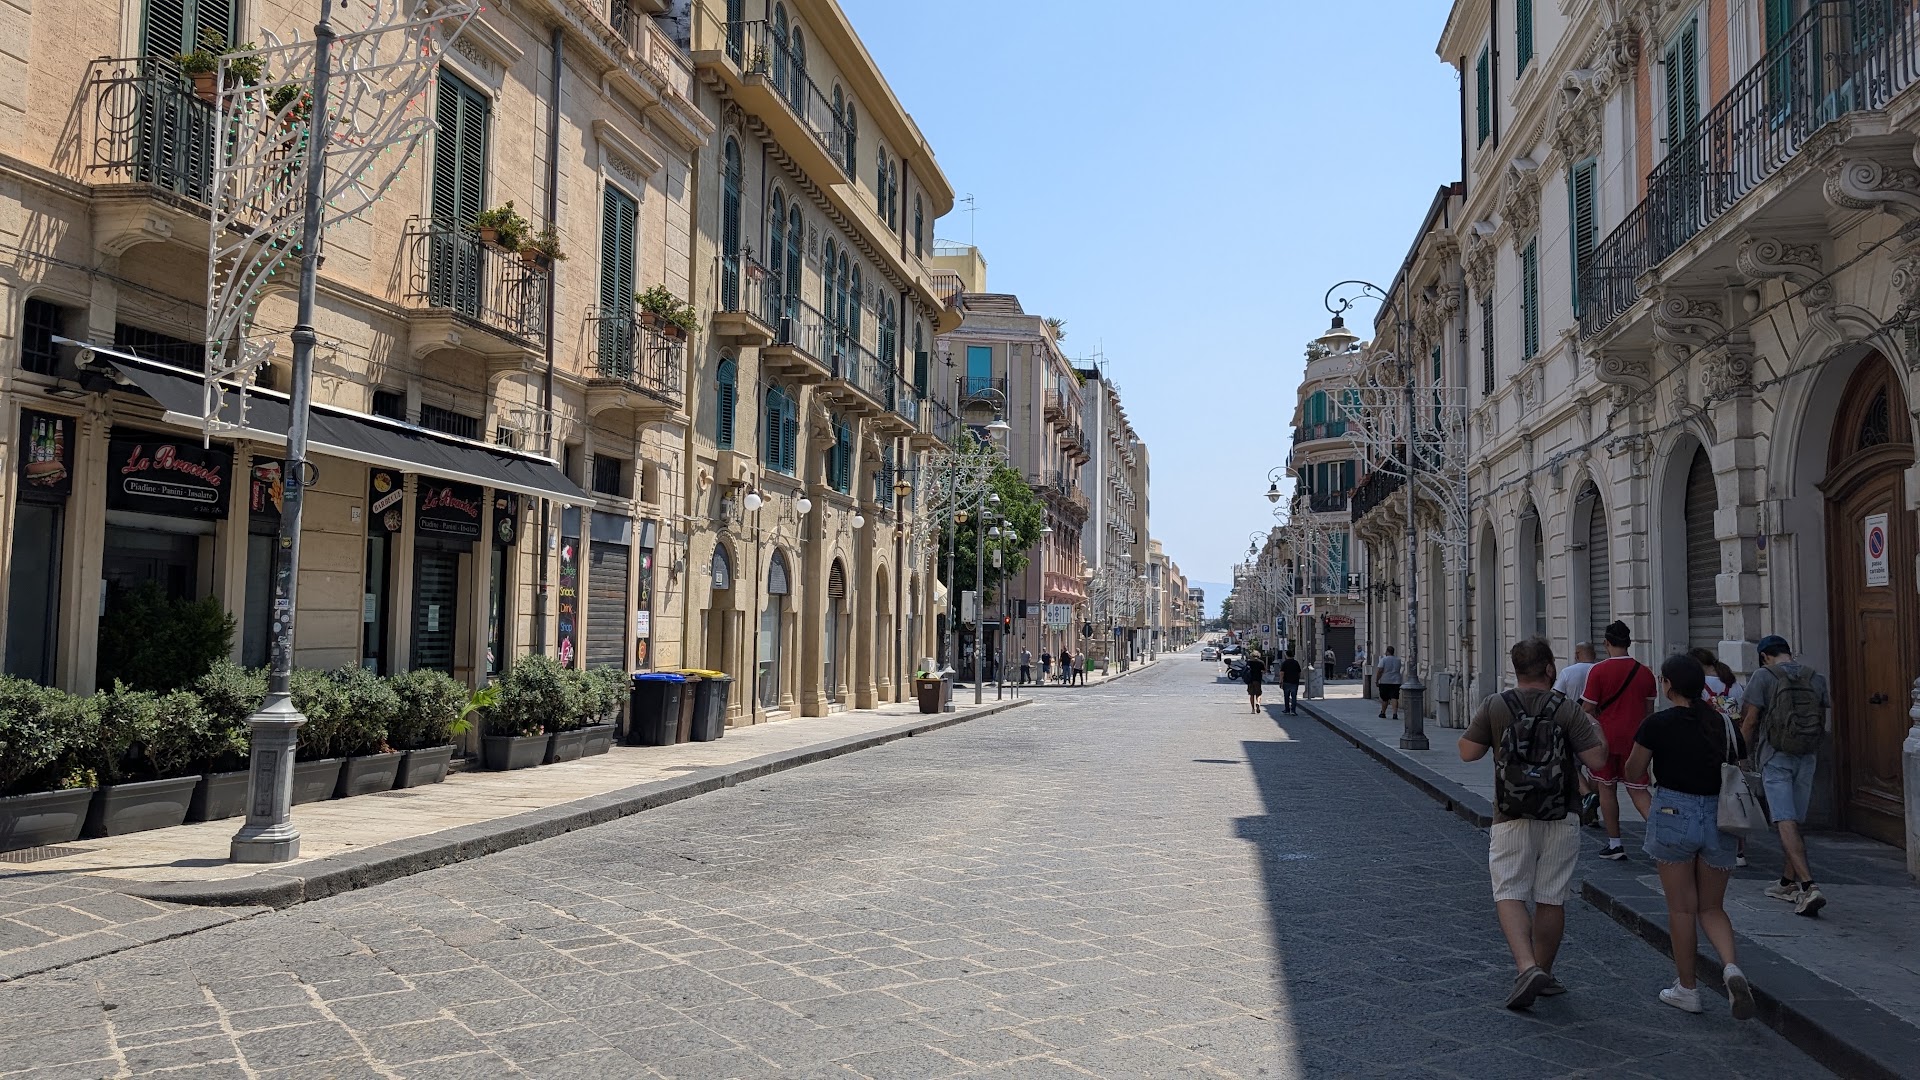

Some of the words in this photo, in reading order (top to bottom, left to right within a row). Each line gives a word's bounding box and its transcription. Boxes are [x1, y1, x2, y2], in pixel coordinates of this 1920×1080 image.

[121, 445, 150, 474] La
[153, 445, 221, 486] Braciola
[130, 482, 156, 493] Piadine
[162, 486, 183, 496] Panini
[560, 586, 576, 598] Snack
[560, 603, 572, 614] Drink
[560, 622, 572, 632] Shop
